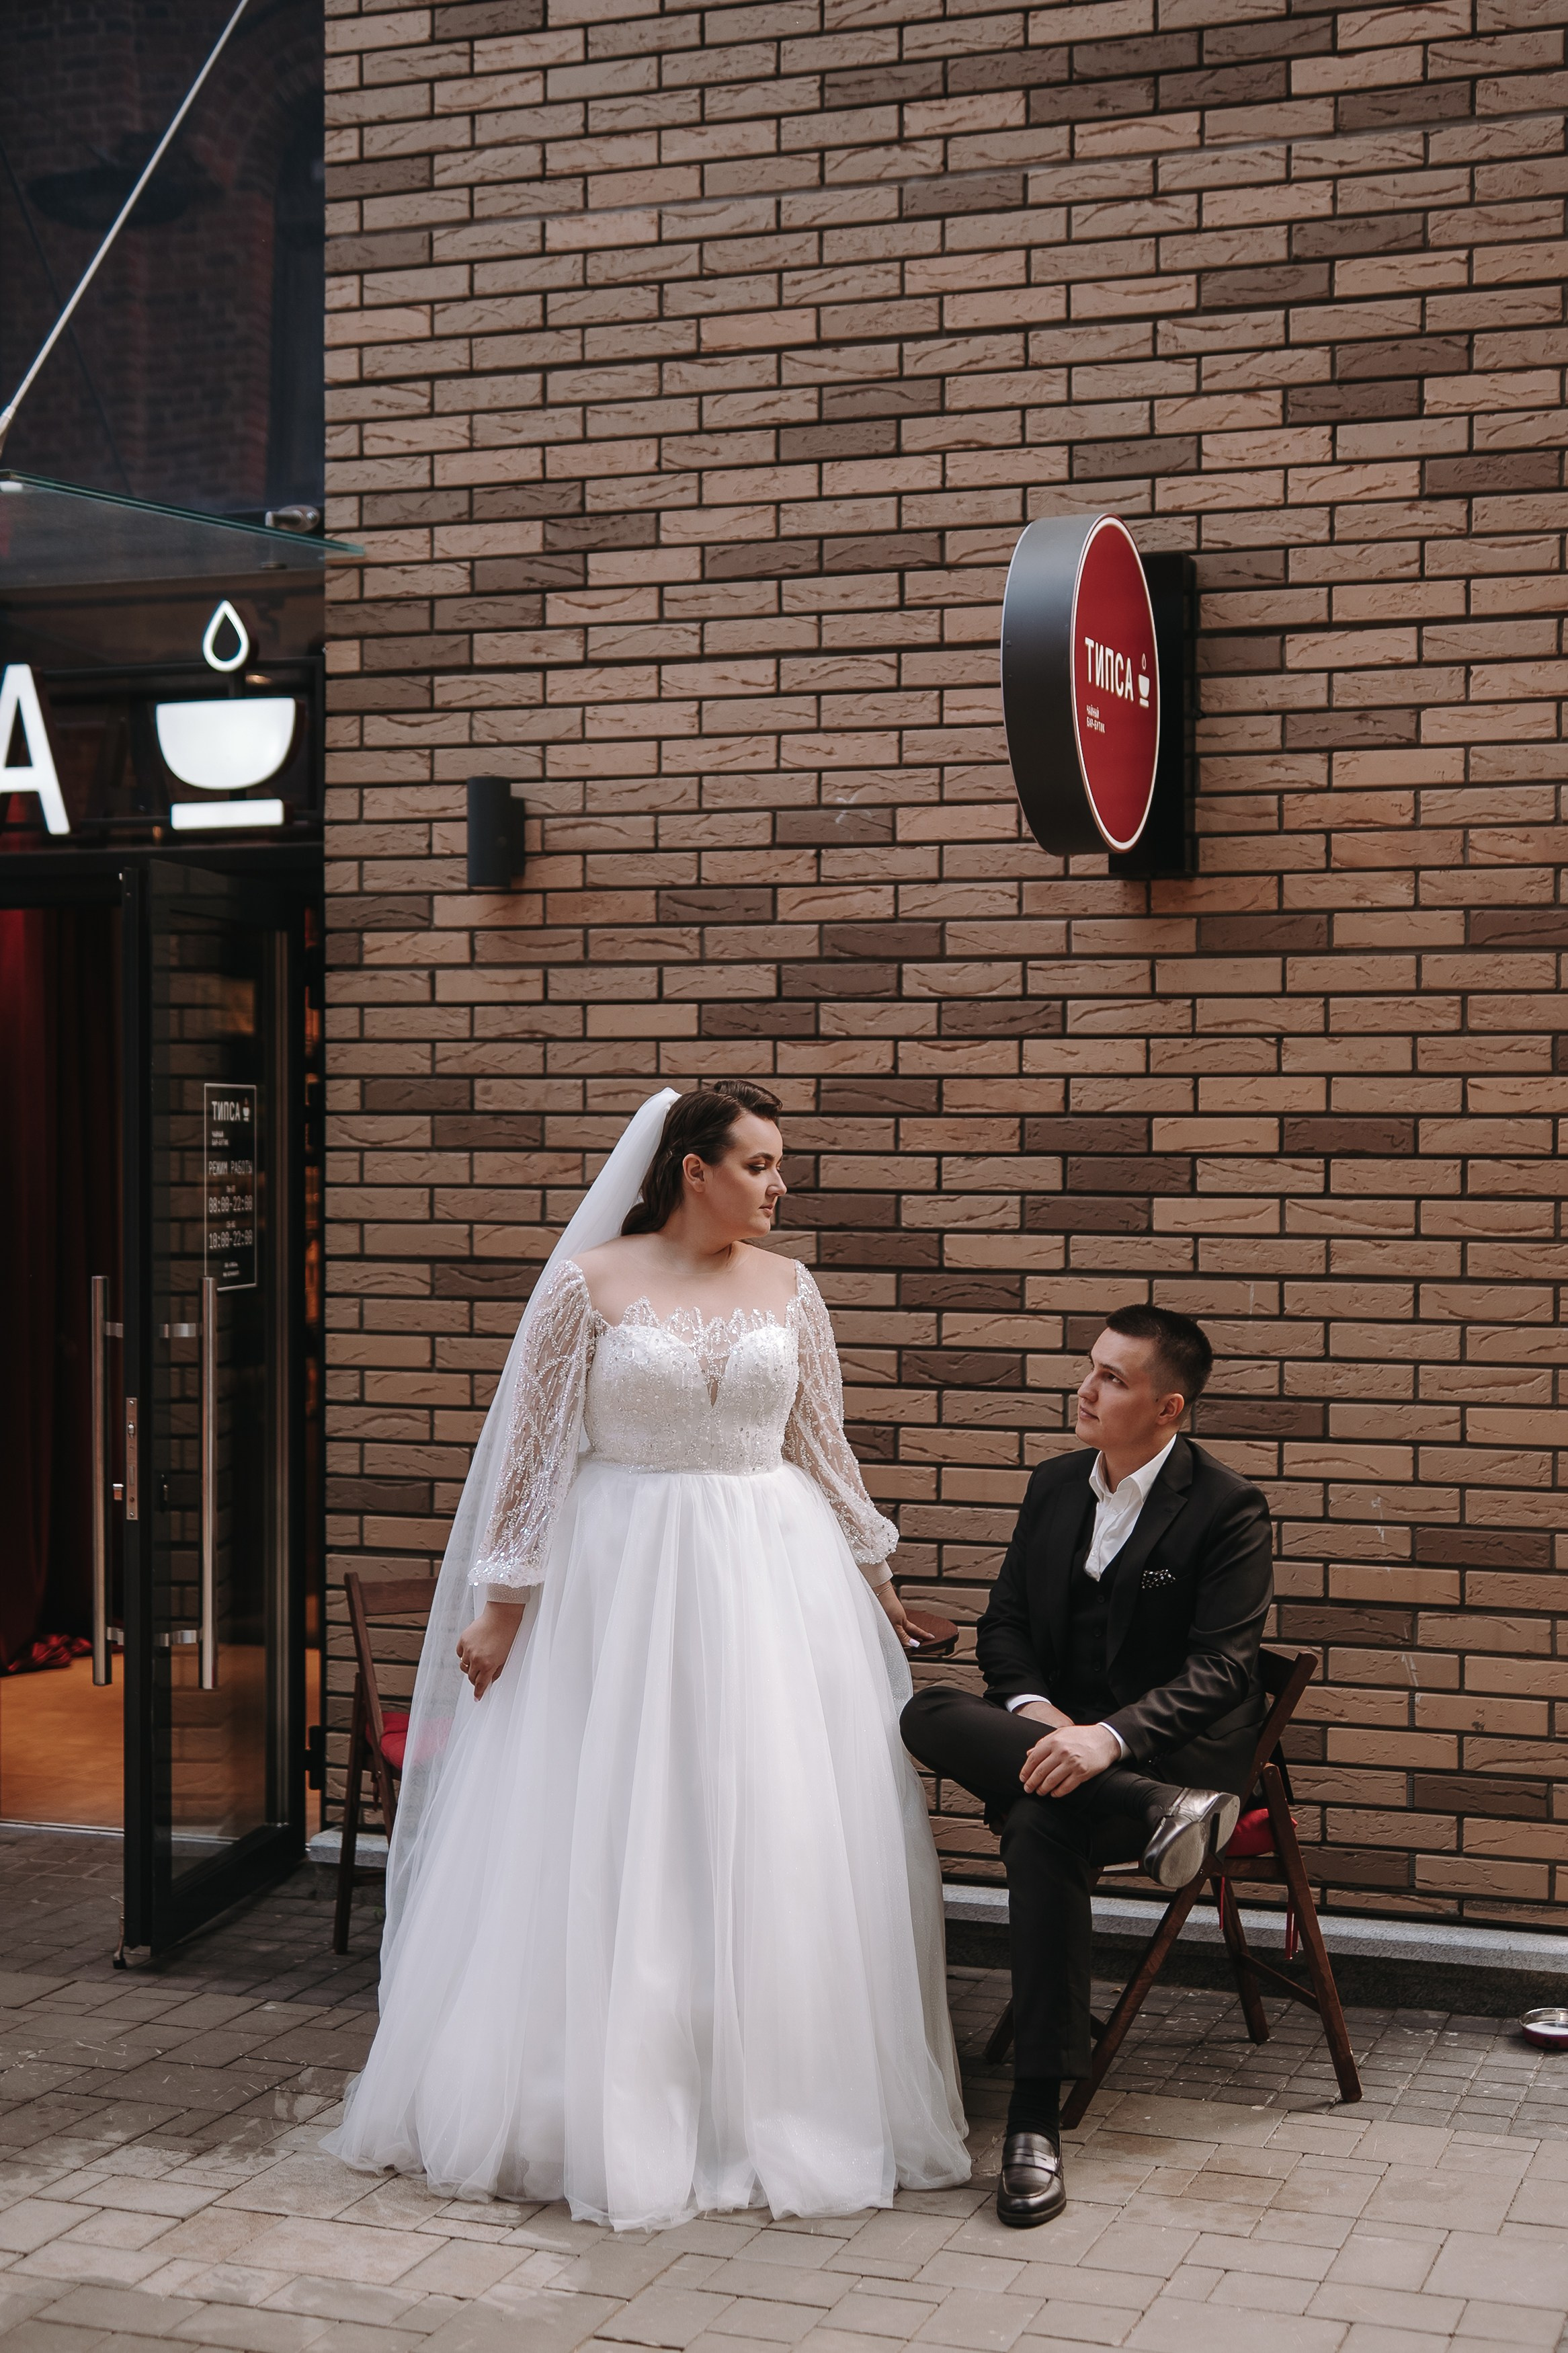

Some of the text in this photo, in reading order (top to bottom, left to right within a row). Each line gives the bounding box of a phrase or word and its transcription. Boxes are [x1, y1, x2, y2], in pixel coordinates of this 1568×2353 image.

[1085, 637, 1134, 702] ТИПСА
[0, 663, 70, 835] А
[211, 1101, 241, 1121] ТИПСА
[208, 1160, 253, 1175] РЕЖИМ РАБОТЫ
